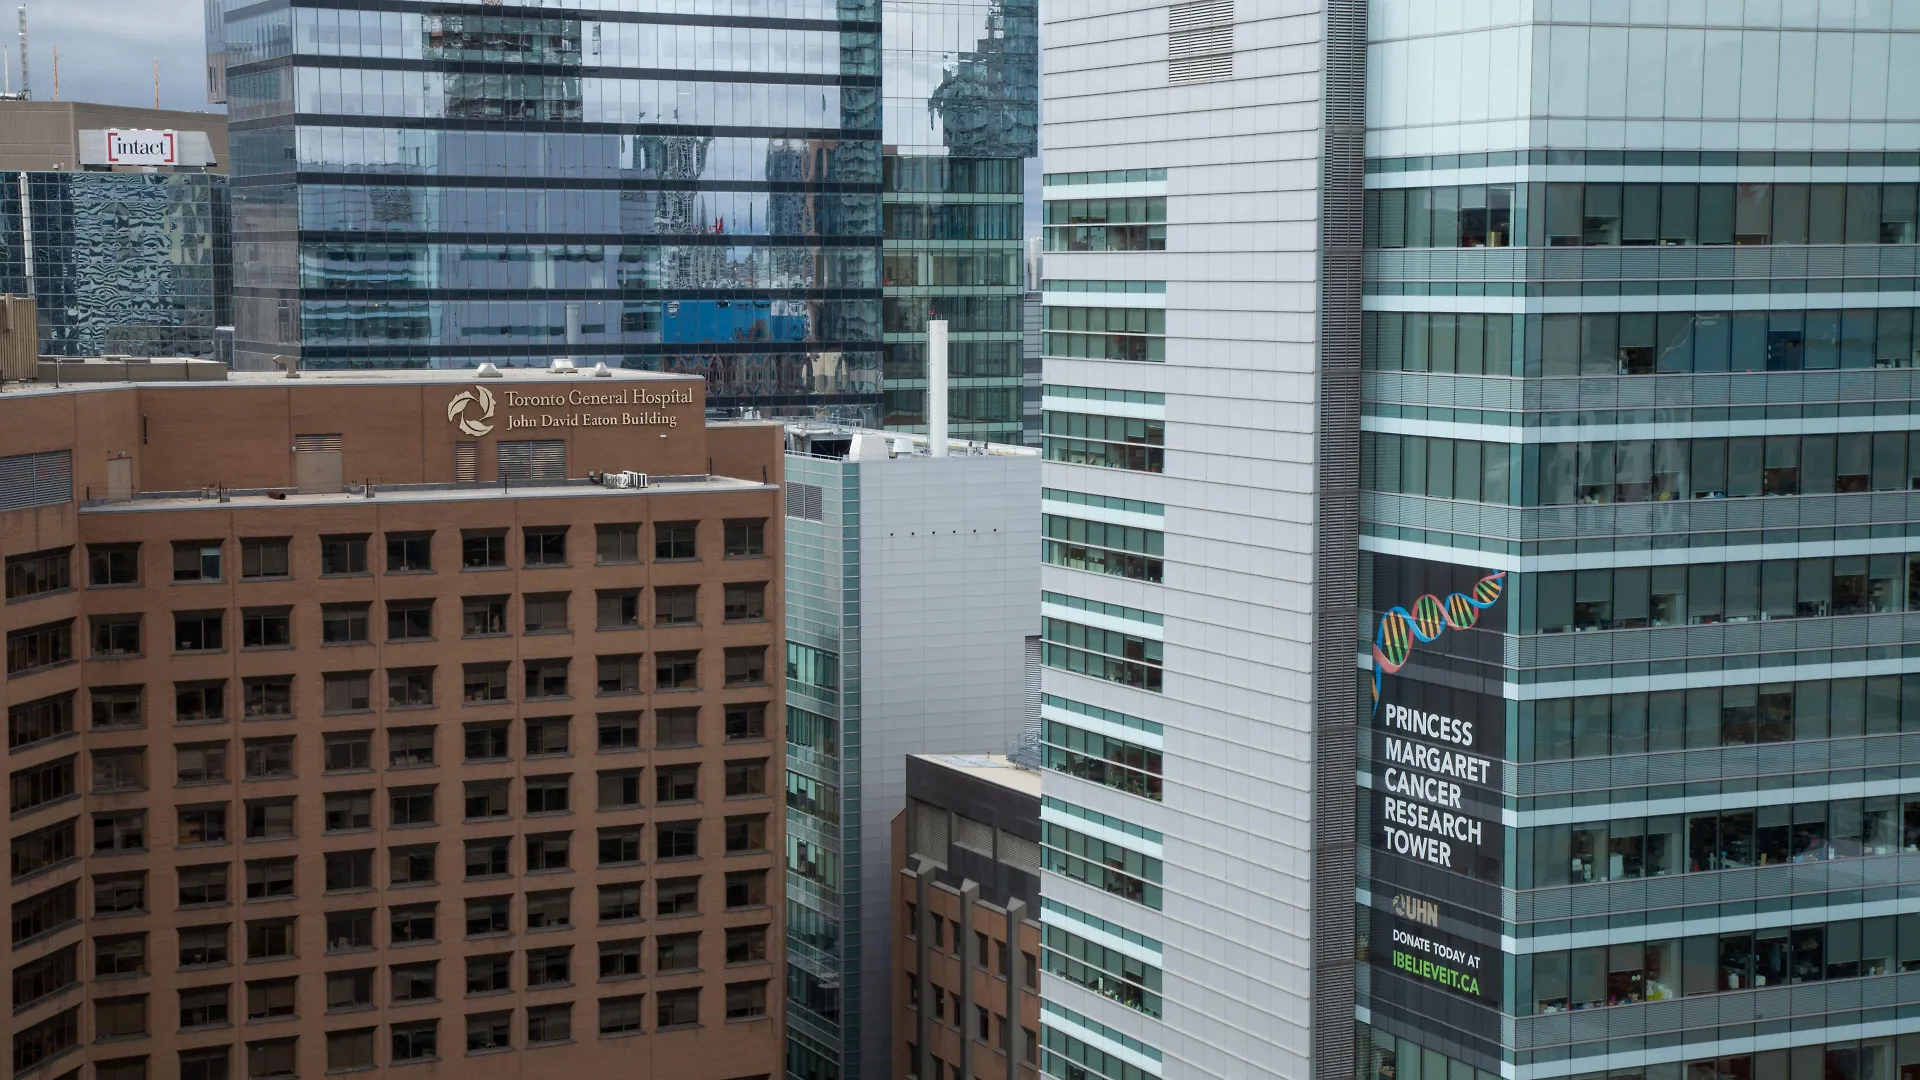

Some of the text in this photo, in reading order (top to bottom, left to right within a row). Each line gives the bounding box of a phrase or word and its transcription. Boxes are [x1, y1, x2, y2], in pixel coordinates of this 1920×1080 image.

[116, 136, 167, 156] intact
[505, 388, 693, 408] Toronto General Hospital
[507, 412, 677, 431] John David Eaton Building
[1385, 703, 1473, 746] PRINCESS
[1385, 737, 1491, 784] MARGARET
[1384, 768, 1462, 809] CANCER
[1384, 796, 1482, 845] RESEARCH
[1384, 826, 1452, 868] TOWER
[1406, 895, 1438, 927] UHN
[1392, 928, 1481, 969] DONATE TODAY AT
[1392, 950, 1481, 996] IBELIEVEIT.CA
